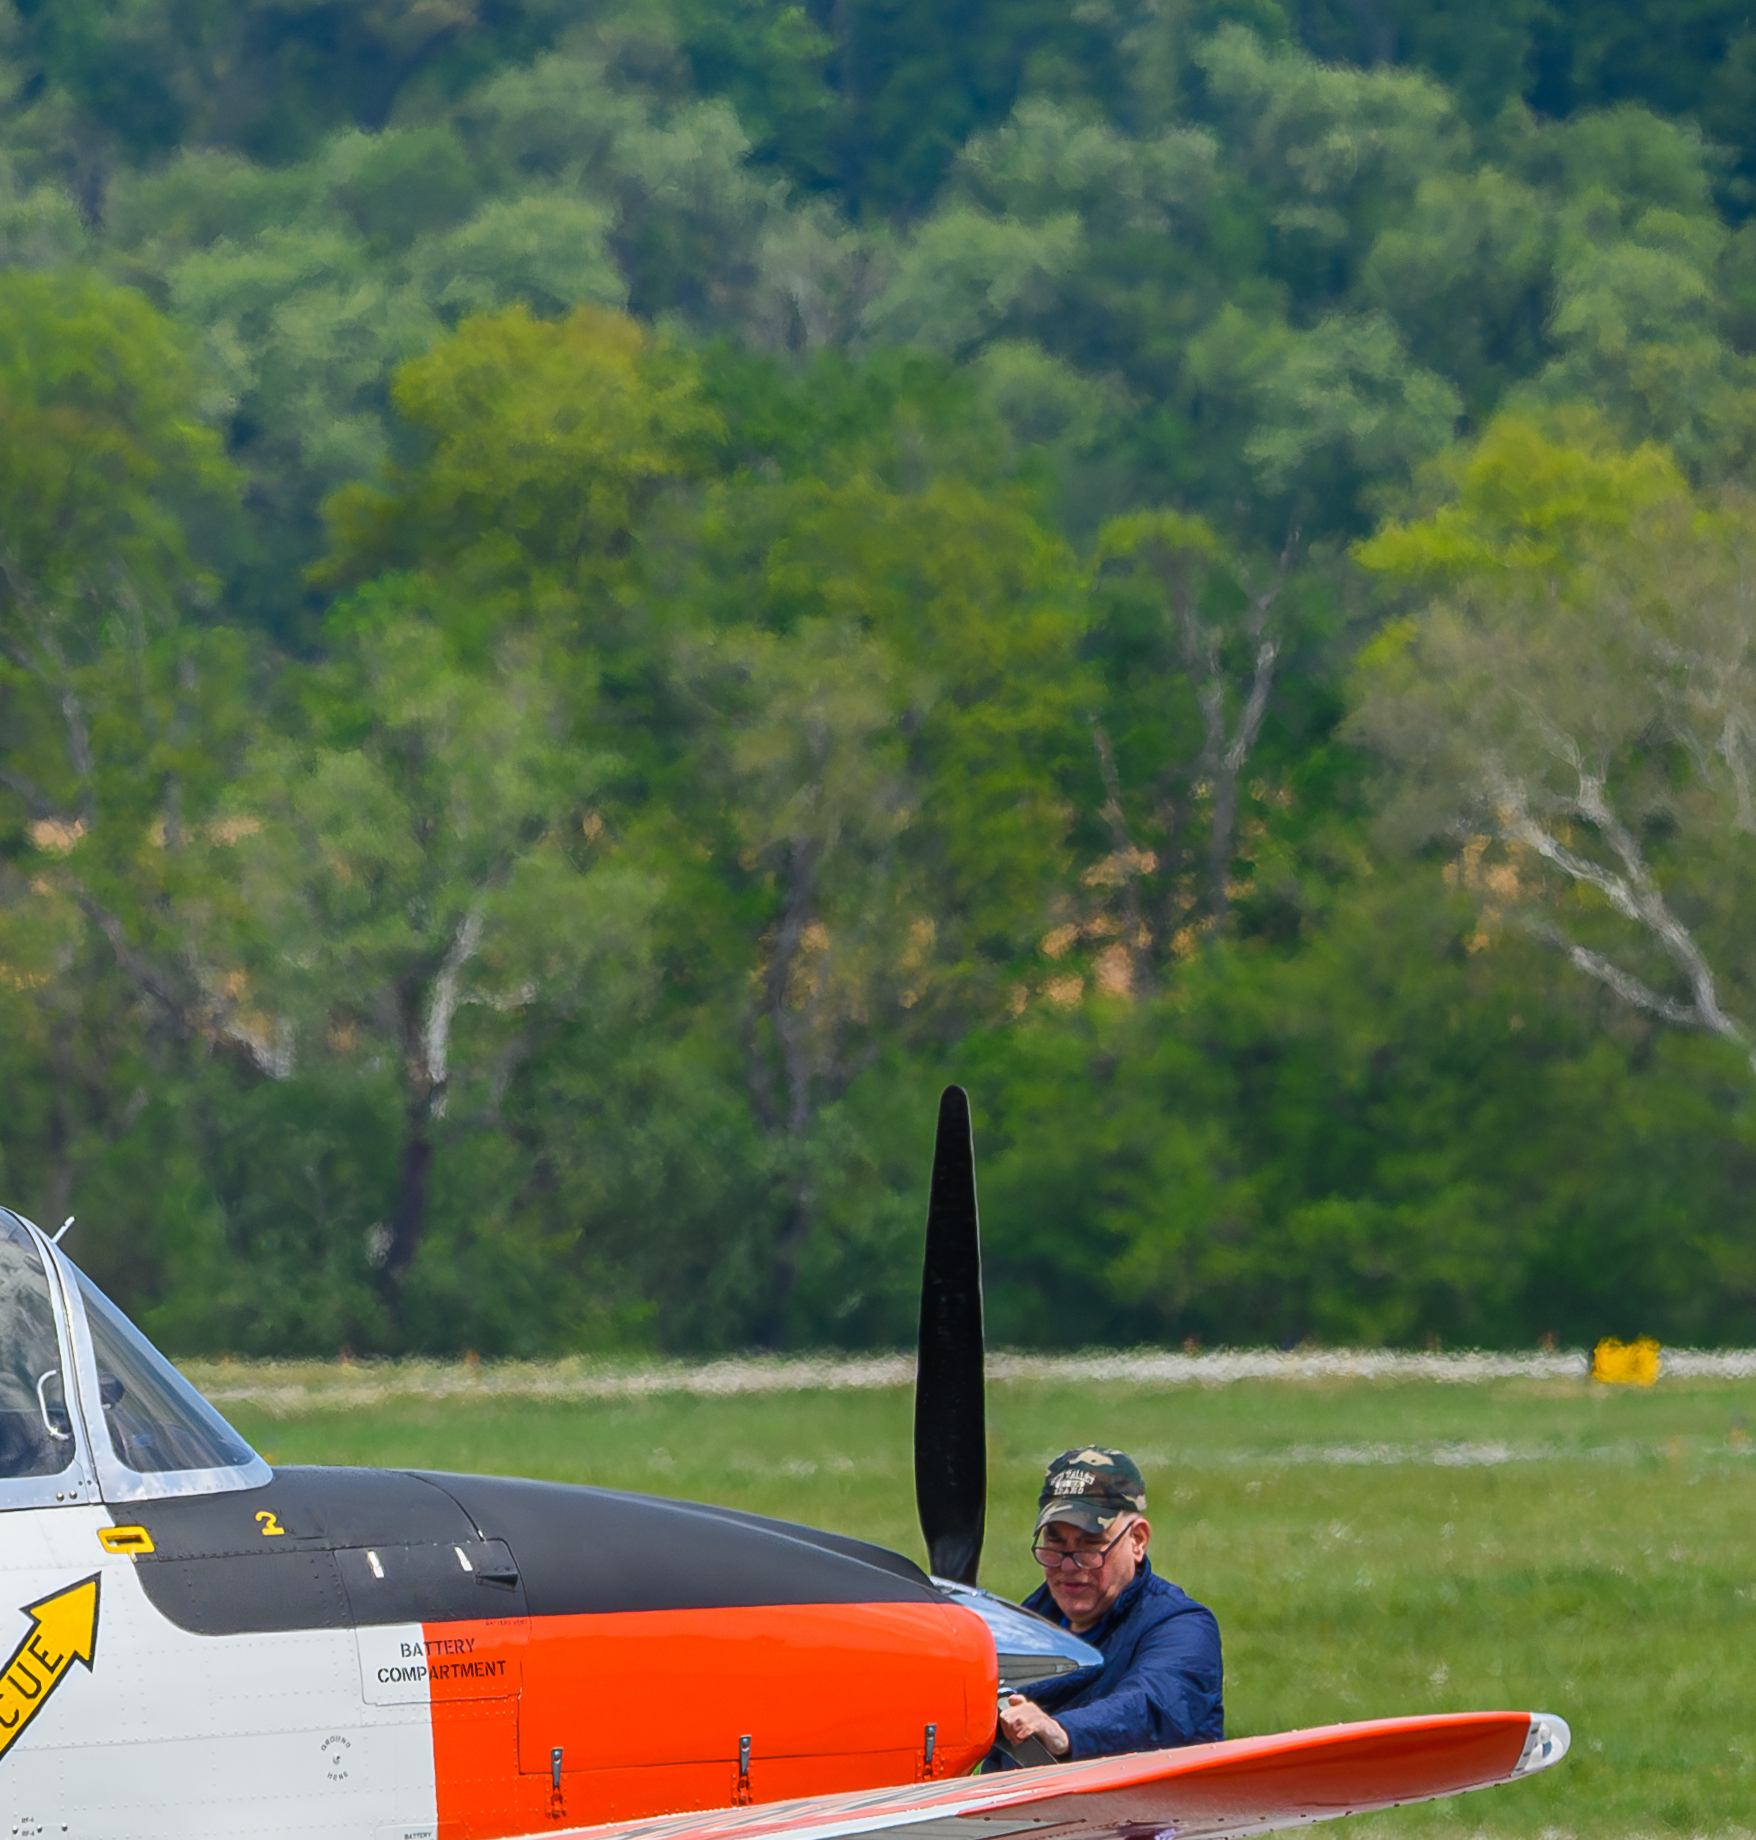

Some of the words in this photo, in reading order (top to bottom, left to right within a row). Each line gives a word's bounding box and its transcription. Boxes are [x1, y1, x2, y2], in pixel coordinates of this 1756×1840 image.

[254, 1510, 286, 1537] 2
[400, 1638, 475, 1658] BATTERY
[377, 1660, 507, 1683] COMPARTMENT
[320, 1735, 352, 1751] GROUND
[327, 1771, 349, 1782] HERE
[404, 1832, 432, 1840] BATTERY
